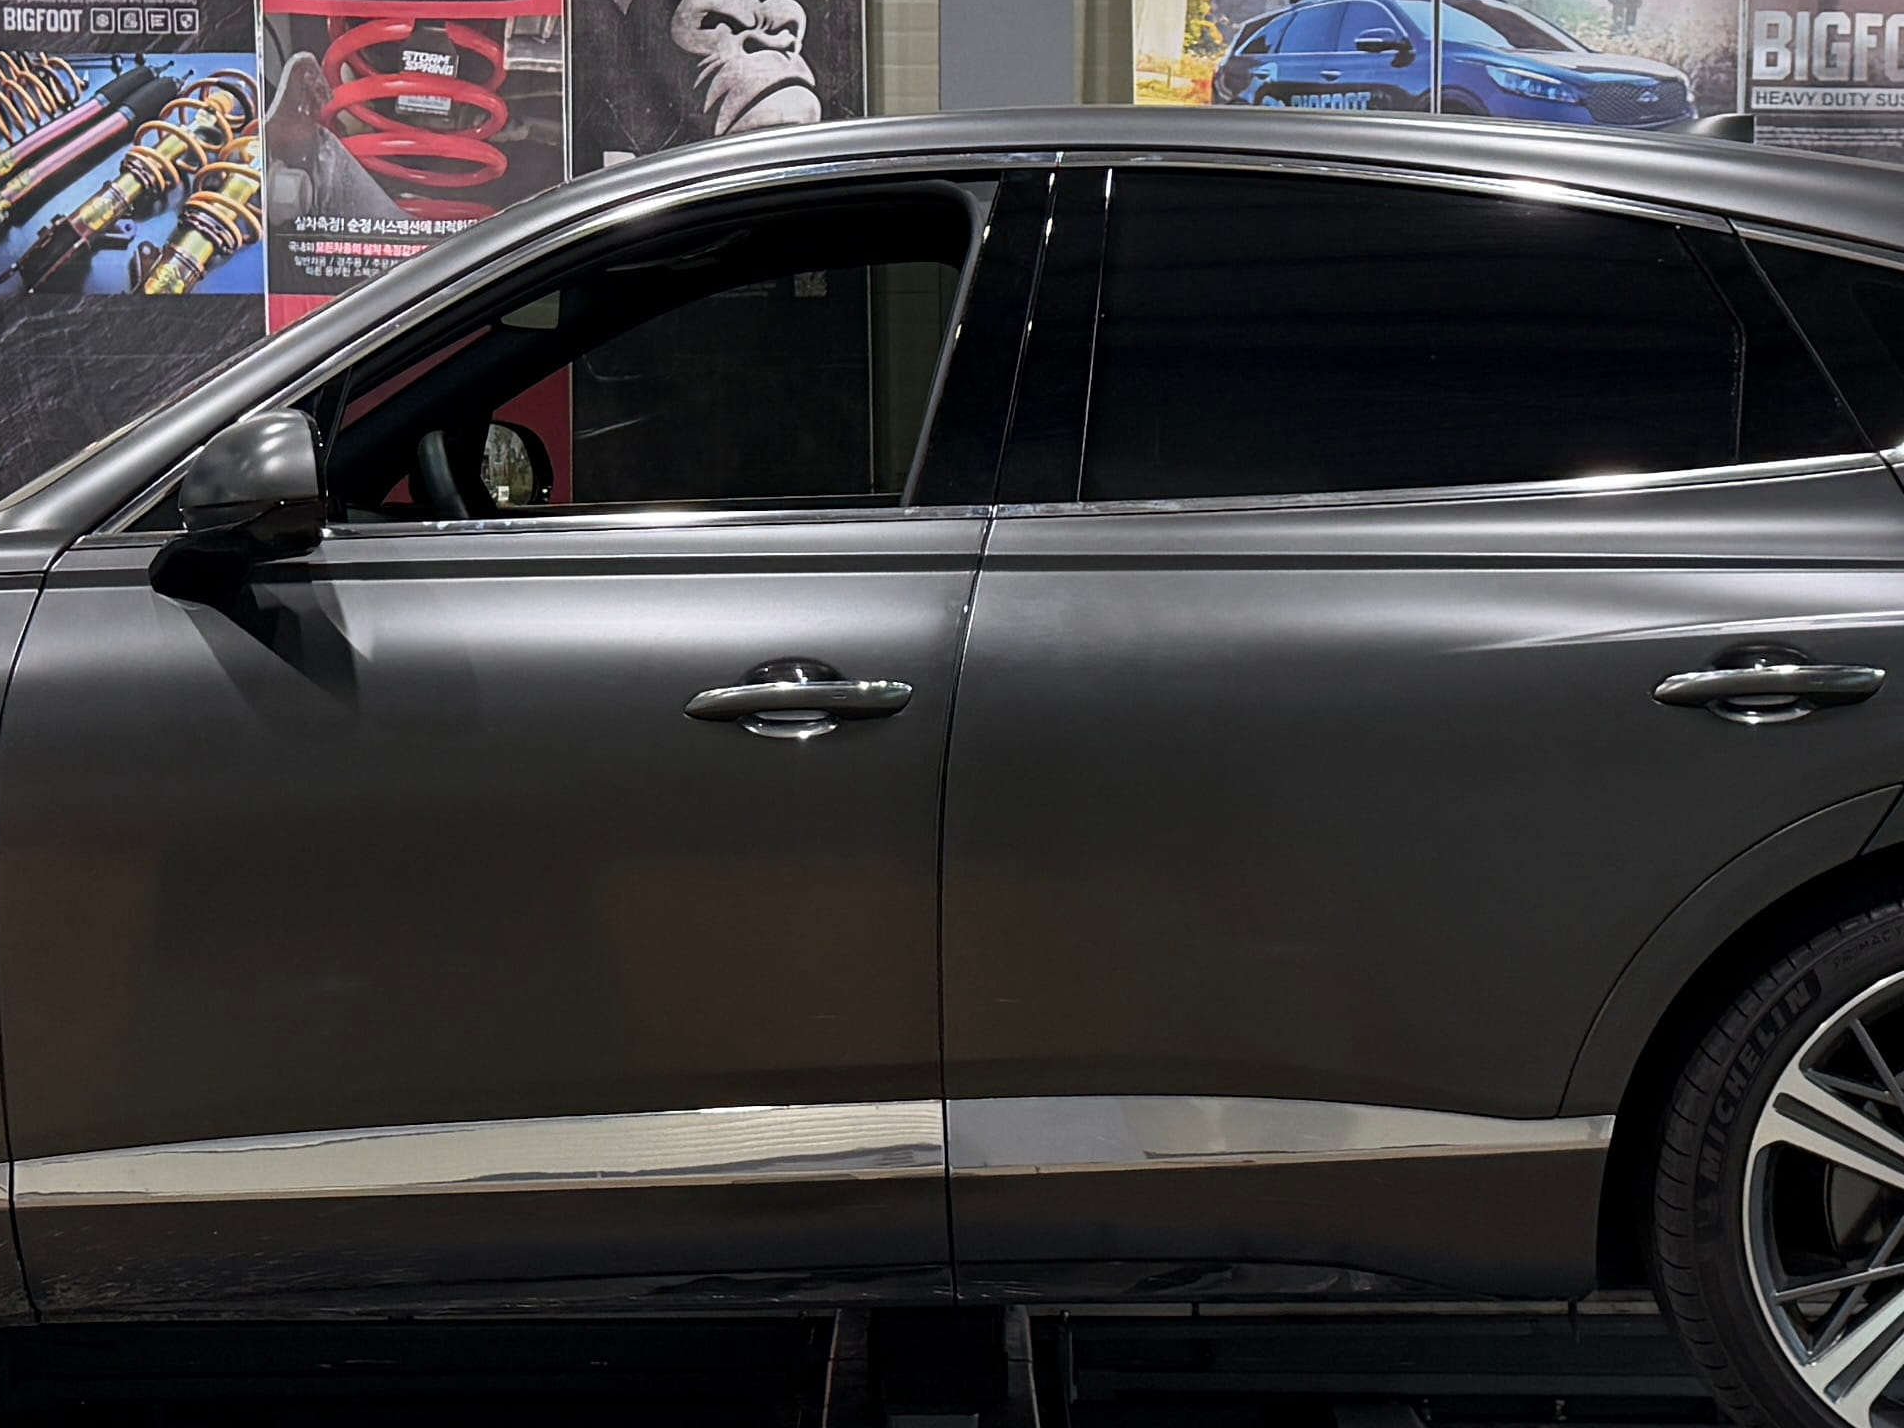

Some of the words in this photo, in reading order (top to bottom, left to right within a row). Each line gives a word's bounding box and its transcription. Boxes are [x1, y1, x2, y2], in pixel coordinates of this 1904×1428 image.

[3, 6, 83, 33] BIGFOOT
[401, 50, 451, 62] STORM
[404, 60, 454, 76] SPRING
[1755, 90, 1816, 107] HEAVY
[1821, 91, 1871, 107] DUTY
[347, 217, 372, 234] 순정
[1700, 979, 1815, 1185] MICHELIN
